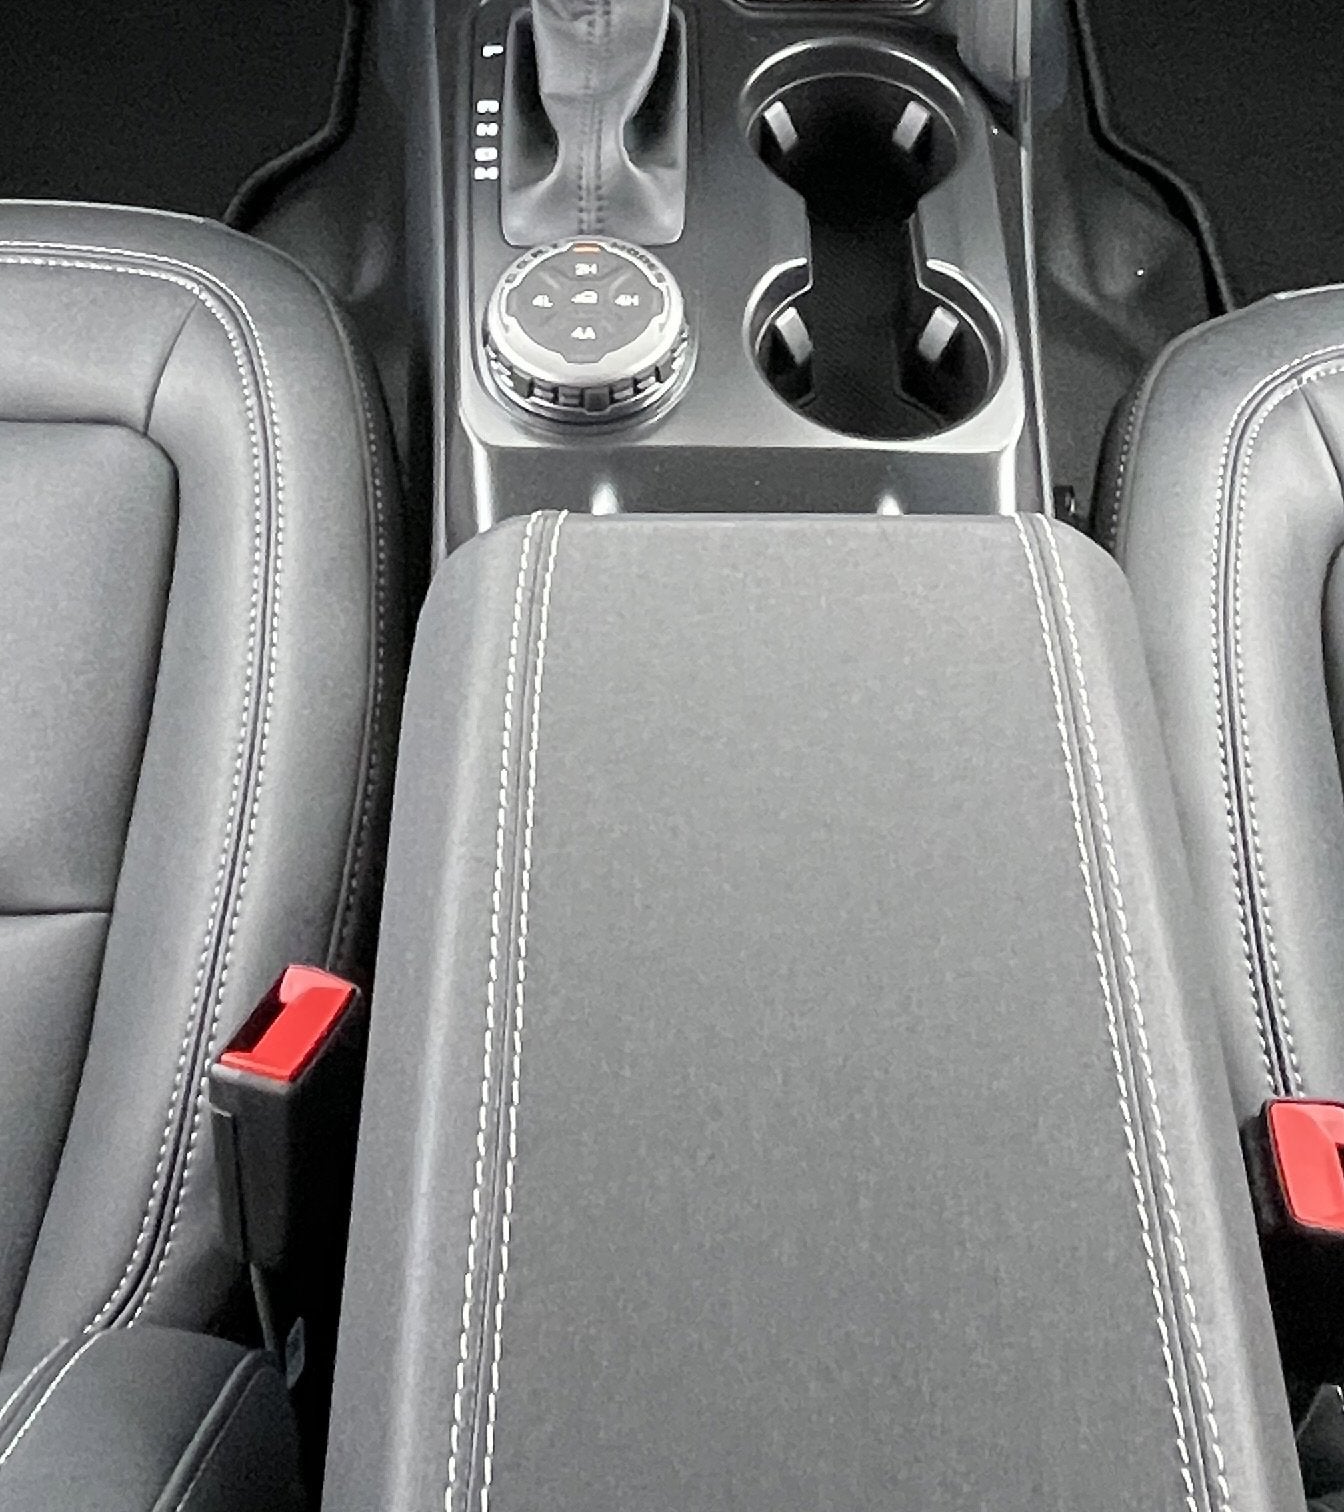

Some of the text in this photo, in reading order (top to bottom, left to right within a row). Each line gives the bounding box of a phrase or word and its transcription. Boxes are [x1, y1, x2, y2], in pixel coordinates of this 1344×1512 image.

[574, 262, 598, 277] 2H
[531, 293, 554, 308] 4L
[613, 293, 640, 308] 4H
[570, 326, 597, 341] 4A
